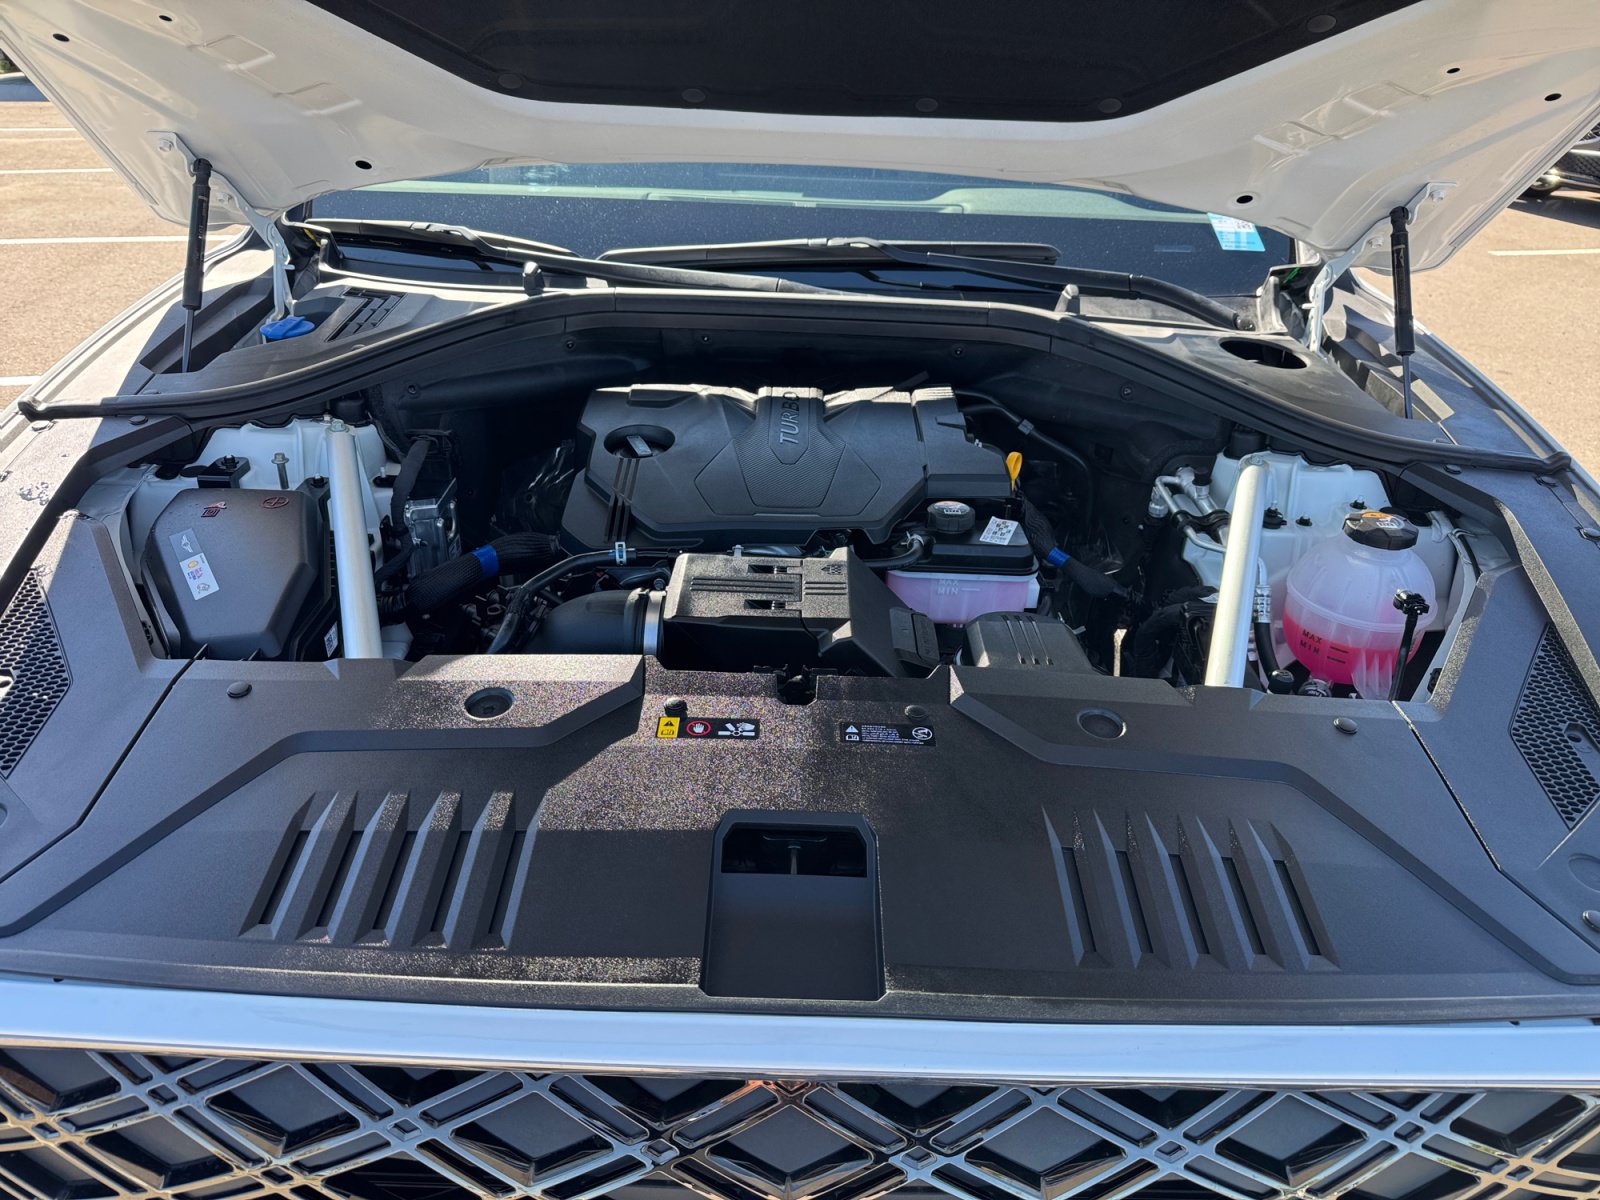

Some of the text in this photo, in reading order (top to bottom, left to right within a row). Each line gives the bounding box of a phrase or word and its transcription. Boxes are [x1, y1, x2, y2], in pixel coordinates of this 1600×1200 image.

[780, 391, 800, 444] TURBO
[937, 586, 959, 595] MIN
[1302, 629, 1322, 645] MAX
[1300, 639, 1320, 655] MIN
